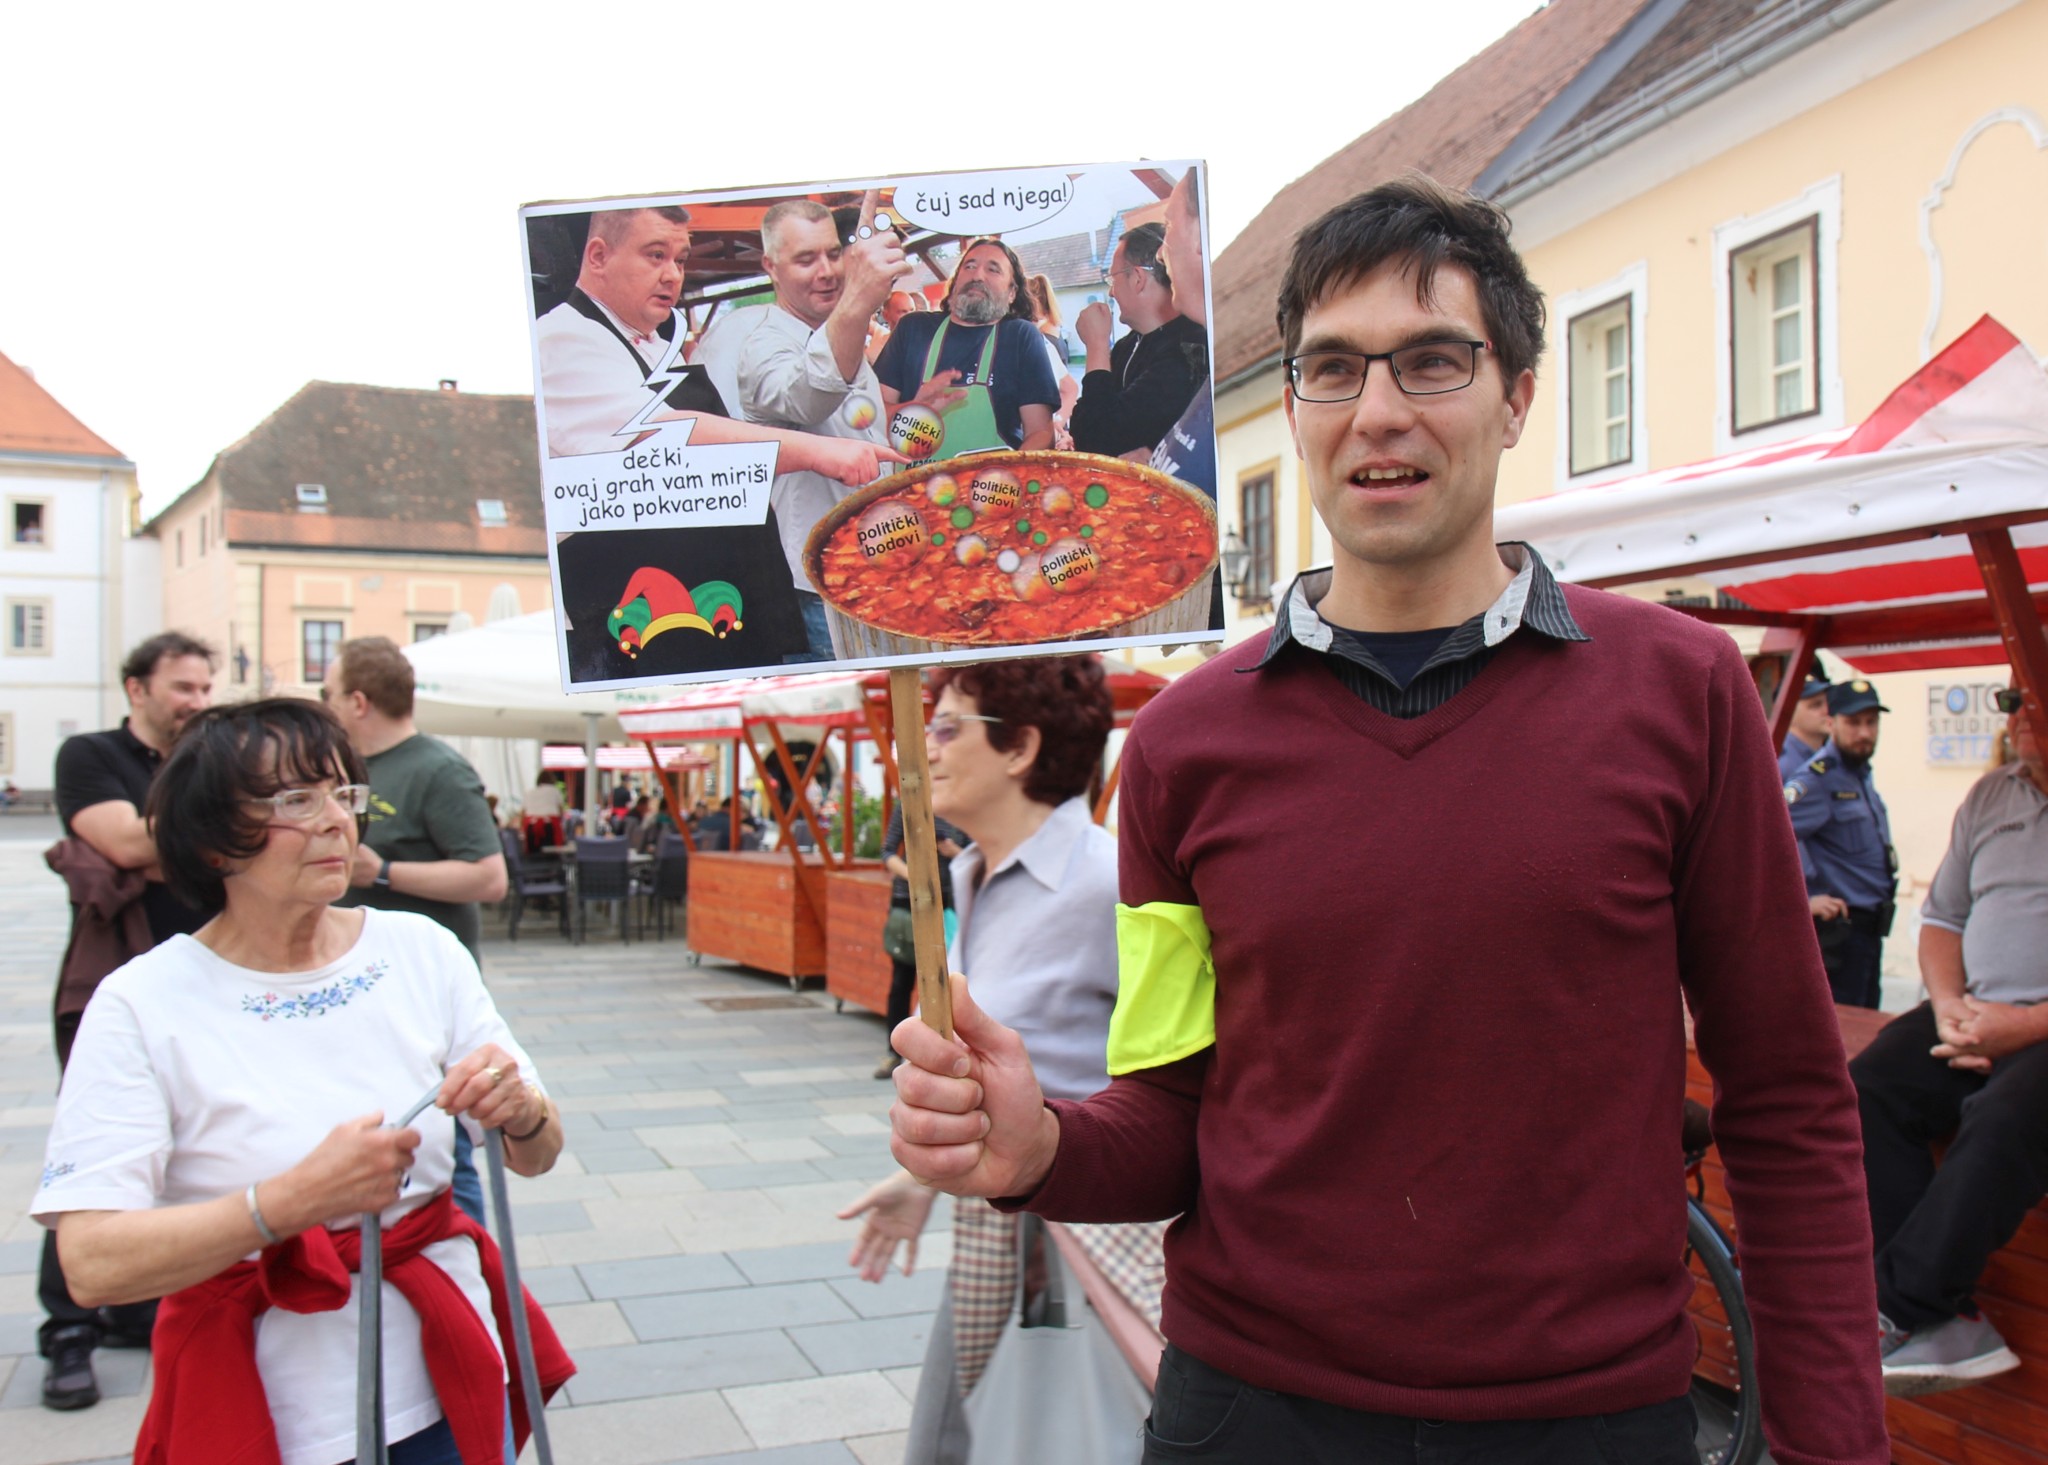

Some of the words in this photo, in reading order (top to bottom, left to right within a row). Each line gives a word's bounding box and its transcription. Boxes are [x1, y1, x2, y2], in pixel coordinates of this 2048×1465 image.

[916, 192, 950, 217] čuj
[958, 187, 995, 210] sad
[1003, 182, 1067, 212] njega!
[891, 423, 933, 450] bodovi
[893, 412, 941, 440] politički
[623, 447, 690, 470] dečki,
[554, 478, 598, 502] ovaj
[606, 473, 655, 500] grah
[662, 474, 703, 490] vam
[711, 464, 768, 487] miriši
[971, 479, 1020, 498] politički
[579, 500, 625, 527] jako
[633, 488, 748, 522] pokvareno!
[972, 491, 1014, 509] bodovi
[857, 512, 920, 545] politički
[865, 530, 921, 557] bodovi
[1041, 543, 1092, 576] politički
[1048, 558, 1094, 585] bodovi
